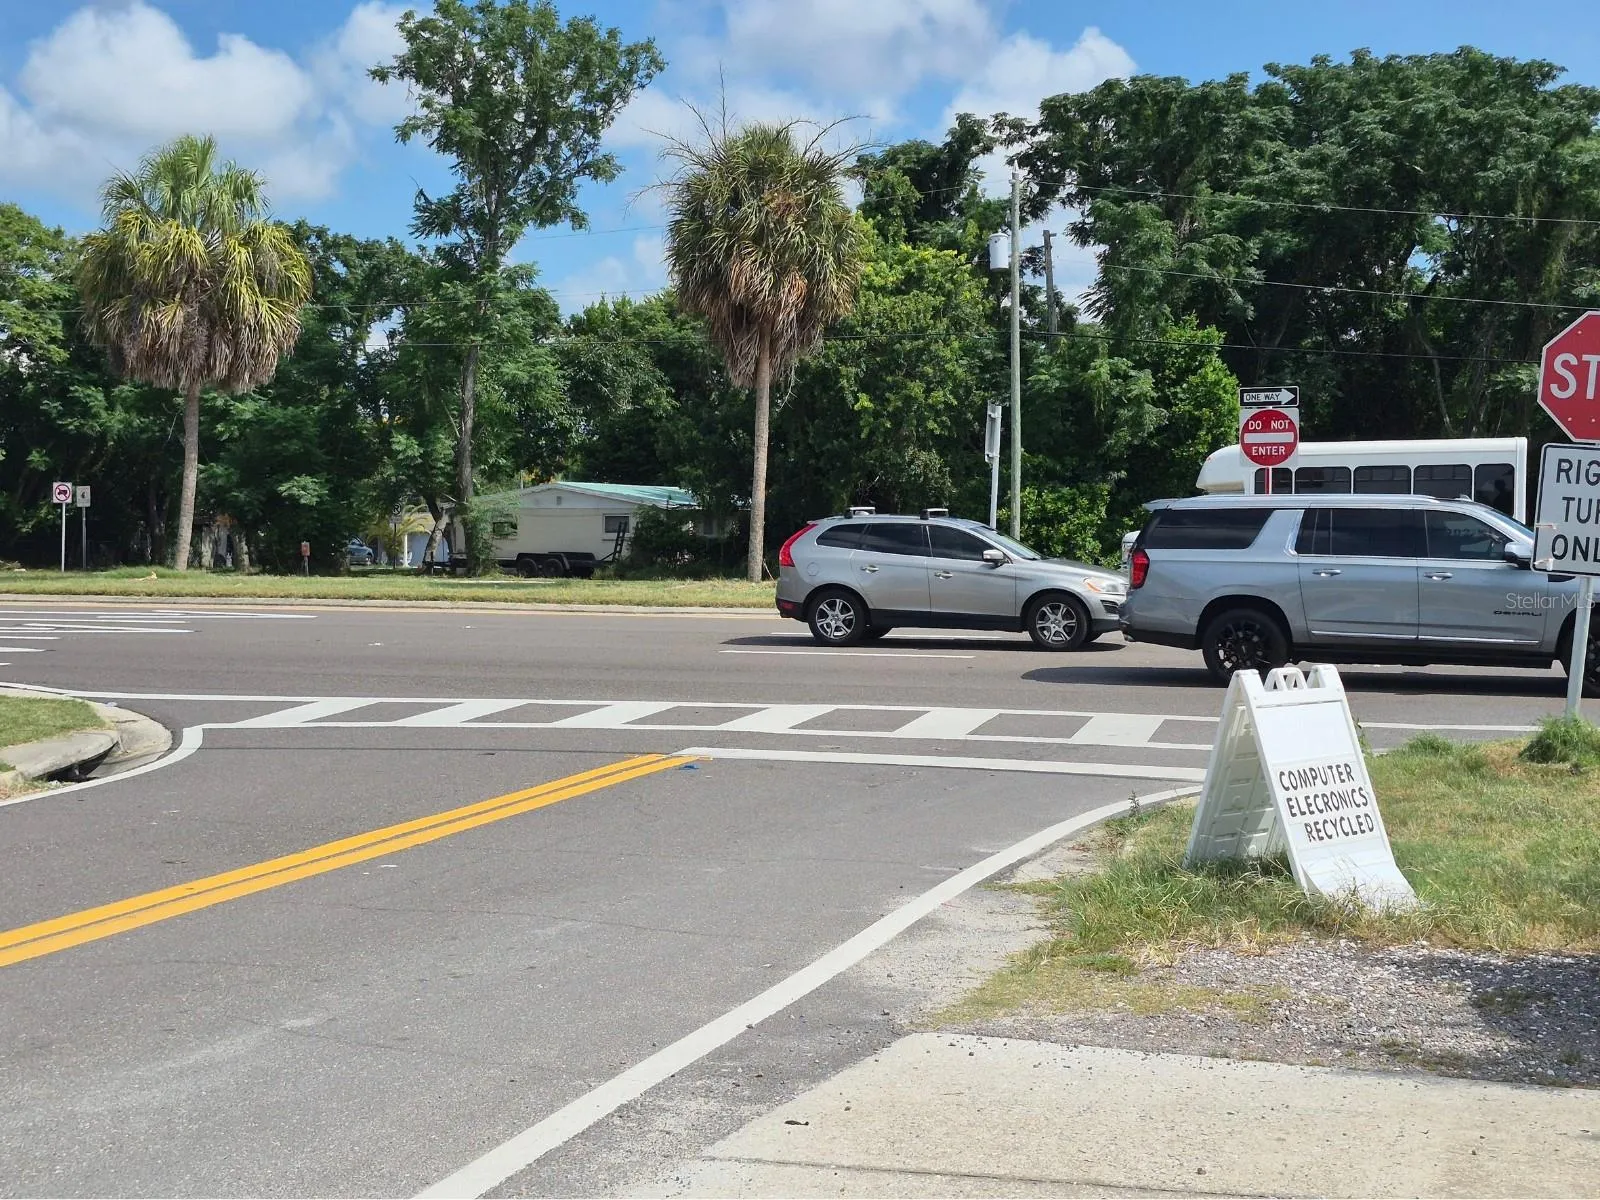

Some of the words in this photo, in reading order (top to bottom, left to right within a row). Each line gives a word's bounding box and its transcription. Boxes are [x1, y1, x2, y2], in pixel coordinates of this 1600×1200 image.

[1248, 420, 1262, 430] DO
[1270, 420, 1290, 429] NOT
[1252, 446, 1286, 456] ENTER
[1279, 763, 1354, 791] COMPUTER
[1286, 787, 1368, 817] ELECRONICS
[1304, 813, 1375, 842] RECYCLED
